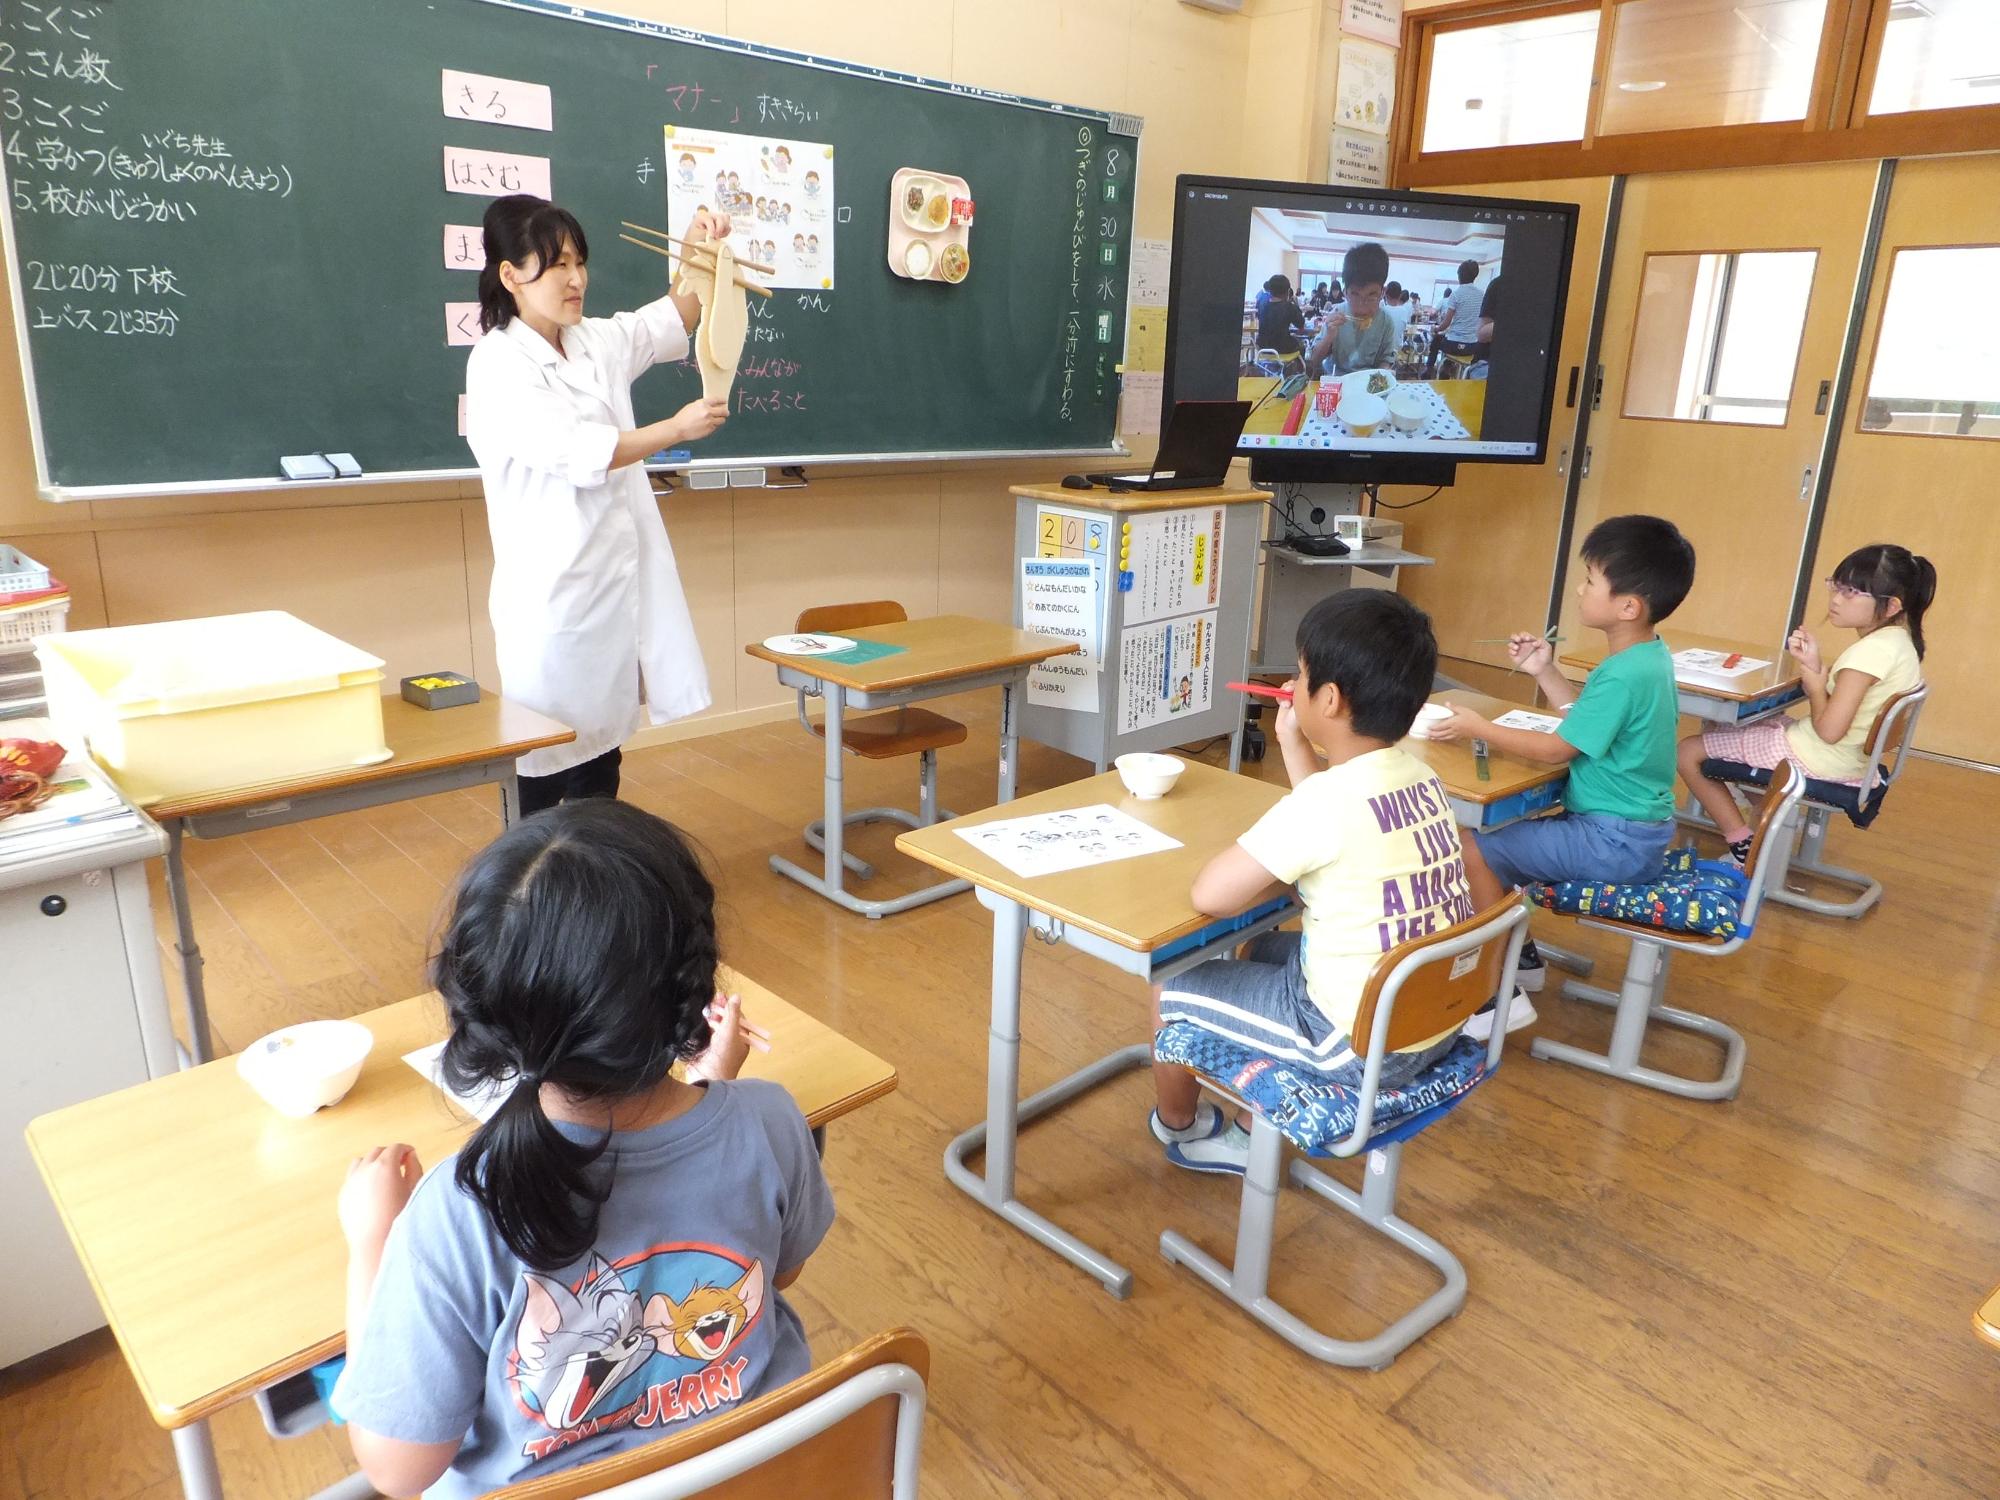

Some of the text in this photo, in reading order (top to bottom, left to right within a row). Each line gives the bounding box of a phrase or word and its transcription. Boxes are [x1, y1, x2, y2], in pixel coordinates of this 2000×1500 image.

[460, 84, 506, 119] きる
[141, 129, 233, 157] いぐち先生
[451, 158, 521, 191] はさむ
[637, 157, 655, 184] 手
[27, 261, 187, 297] 2じ20分 下校
[33, 303, 180, 337] 上バス 2じ35分
[737, 387, 807, 414] たべること
[1045, 518, 1054, 538] 2
[1066, 520, 1077, 544] 0
[1025, 565, 1044, 575] さんすう
[1195, 536, 1205, 583] じぶんが
[1034, 583, 1087, 594] どんなもんだいかな
[1035, 603, 1080, 613] めあてのかくにん
[1035, 625, 1087, 637] じぶんでかんがえよう
[1037, 664, 1088, 676] れんしゅうもんだい
[1038, 682, 1066, 693] ふりかえり
[1367, 776, 1452, 834] WAYS T
[1413, 818, 1460, 867] LIVE
[1382, 858, 1471, 917] A HAPP
[633, 1355, 749, 1429] JERRY
